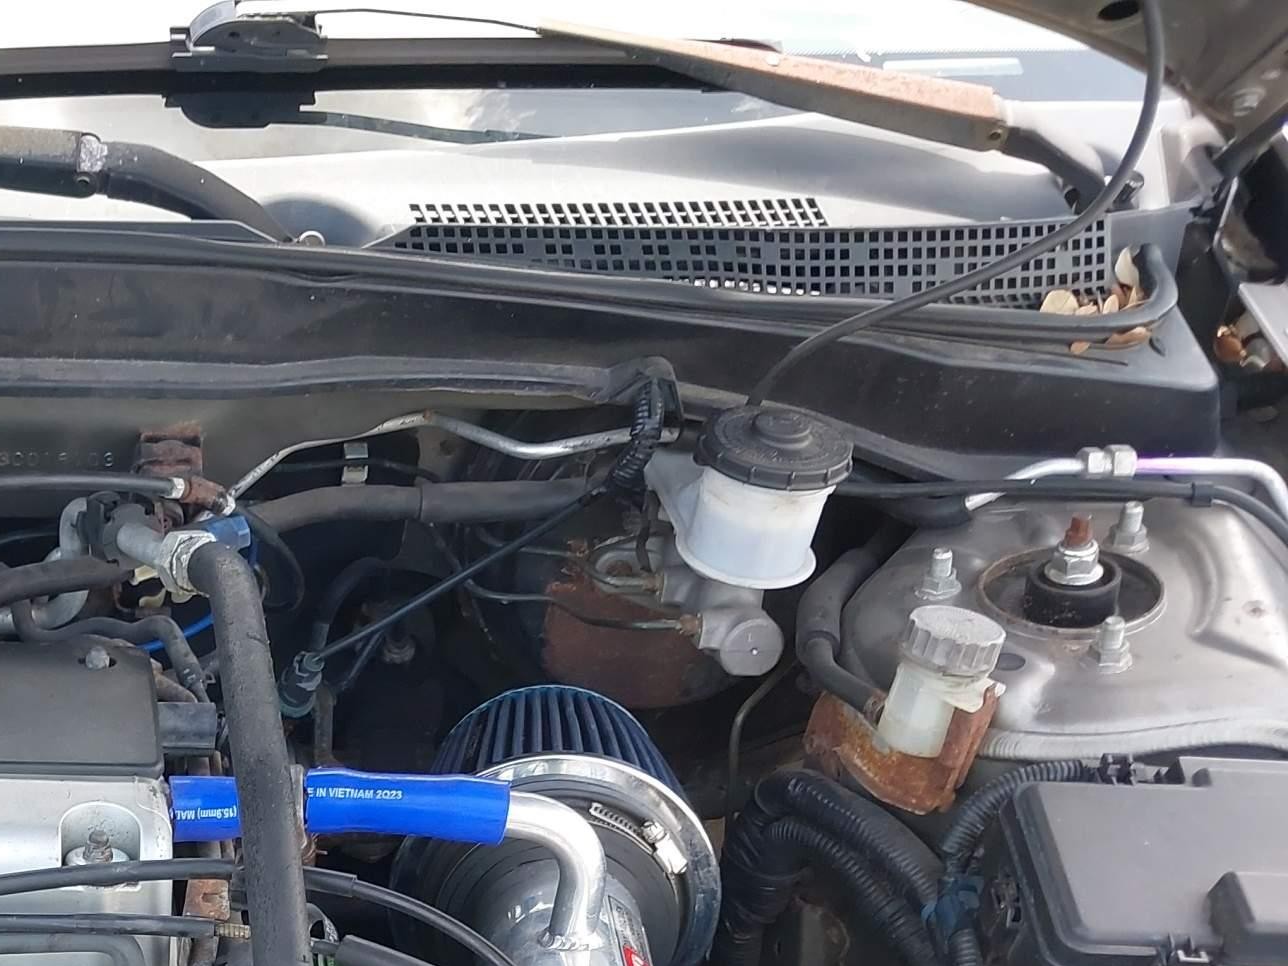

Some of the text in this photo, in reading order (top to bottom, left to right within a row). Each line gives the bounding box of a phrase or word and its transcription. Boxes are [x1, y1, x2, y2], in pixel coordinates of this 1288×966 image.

[316, 788, 327, 798] IN
[329, 789, 373, 799] VIETNAM
[197, 805, 236, 819] (15.9mm)
